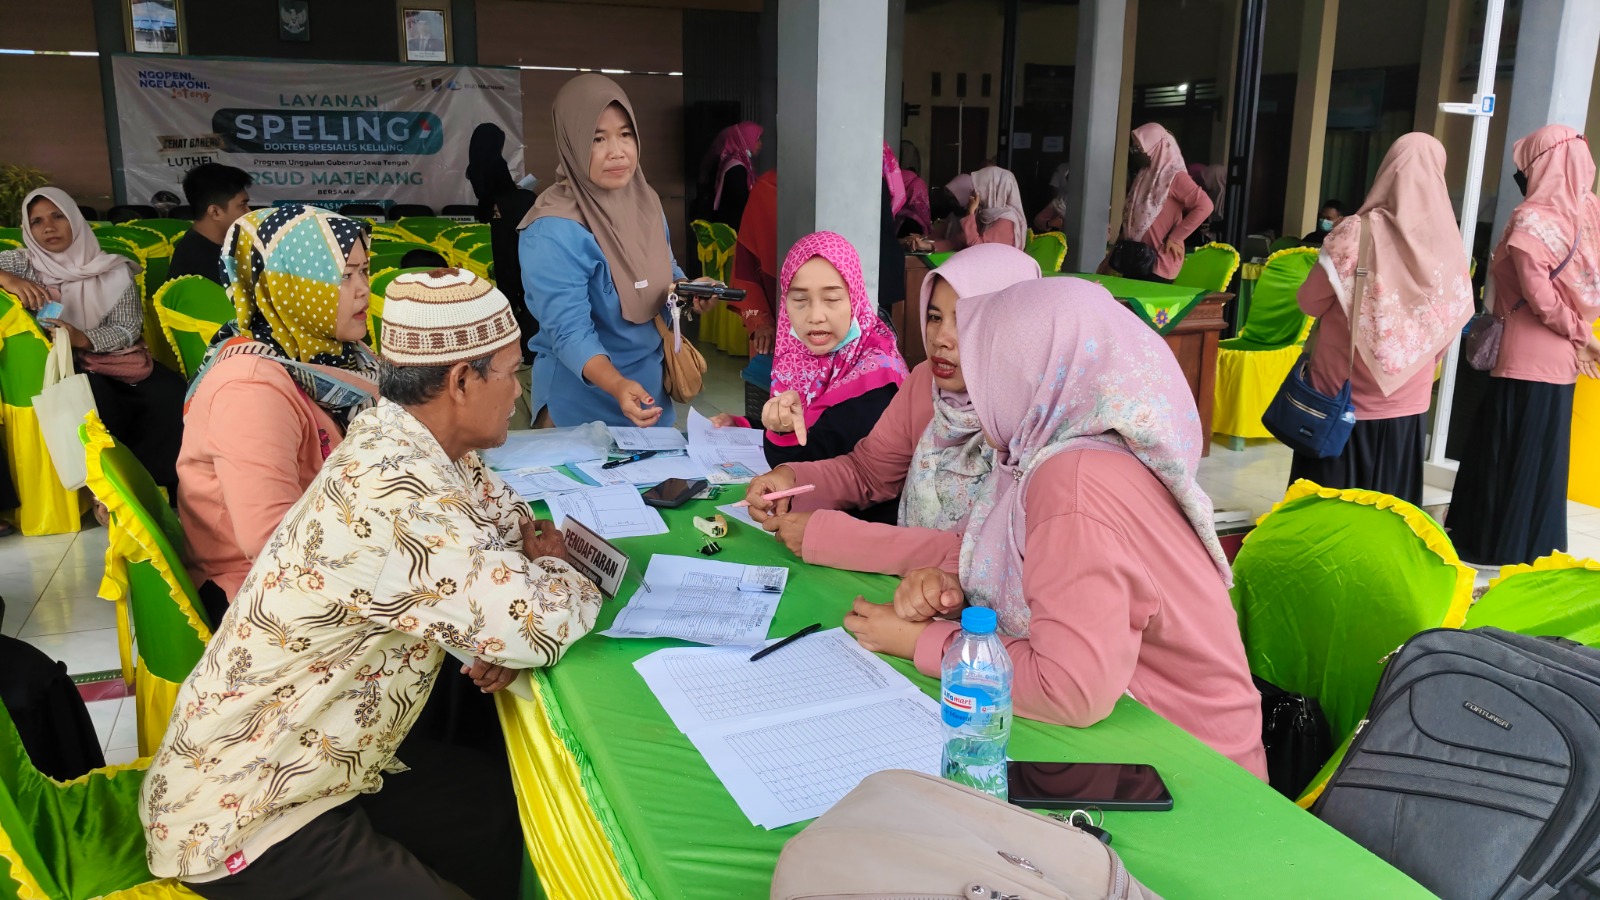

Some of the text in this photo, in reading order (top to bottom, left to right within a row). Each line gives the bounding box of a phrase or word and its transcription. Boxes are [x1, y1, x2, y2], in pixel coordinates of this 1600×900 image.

[138, 71, 195, 80] NGOPENI.
[140, 80, 211, 89] NGELAKONI.
[279, 93, 379, 108] LAYANAN
[235, 114, 410, 142] SPELING
[264, 142, 403, 152] DOKTER SPESIALIS KELILING
[253, 159, 286, 167] Program
[288, 159, 326, 167] Unggulan
[251, 171, 423, 186] RSUD MAJENANG
[564, 528, 619, 579] PENDAFTARAN
[1464, 701, 1510, 728] FORTUNER
